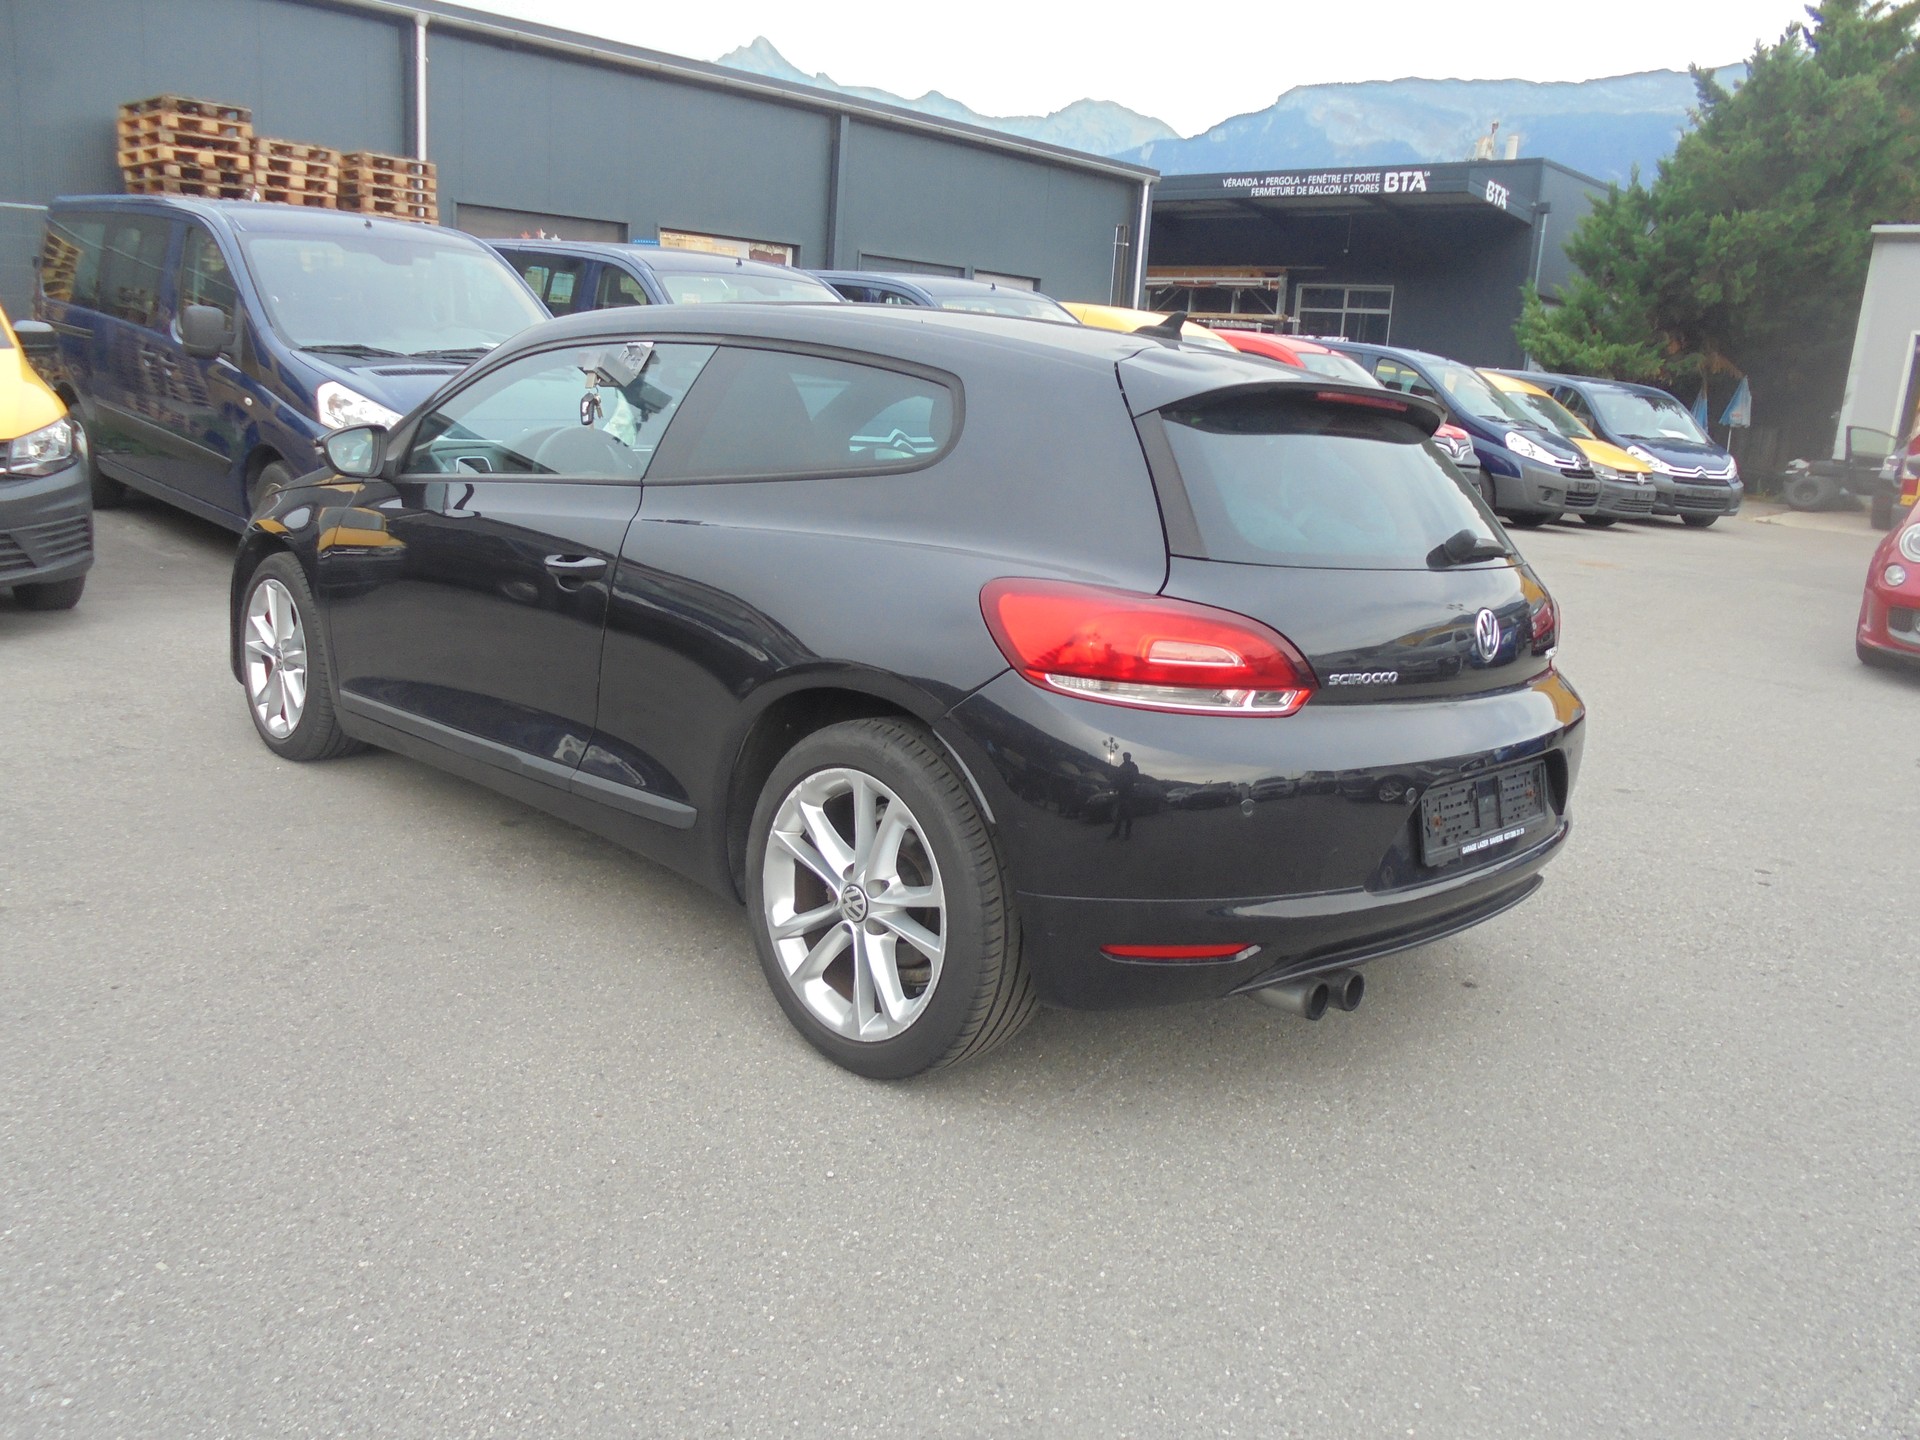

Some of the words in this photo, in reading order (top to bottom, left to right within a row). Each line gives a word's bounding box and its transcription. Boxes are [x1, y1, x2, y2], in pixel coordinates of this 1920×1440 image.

[1223, 177, 1258, 188] VÉRANDA
[1265, 176, 1300, 186] PERGOLA
[1307, 173, 1341, 185] FENÊTRE
[1343, 174, 1352, 183] ET
[1354, 173, 1381, 183] PORTE
[1384, 171, 1427, 192] BTA
[1250, 187, 1295, 197] FERMETURE
[1296, 186, 1308, 195] DE
[1308, 185, 1342, 195] BALCON
[1349, 184, 1380, 194] STORES
[1486, 180, 1507, 209] BTA
[1328, 671, 1399, 686] SCIROCCO
